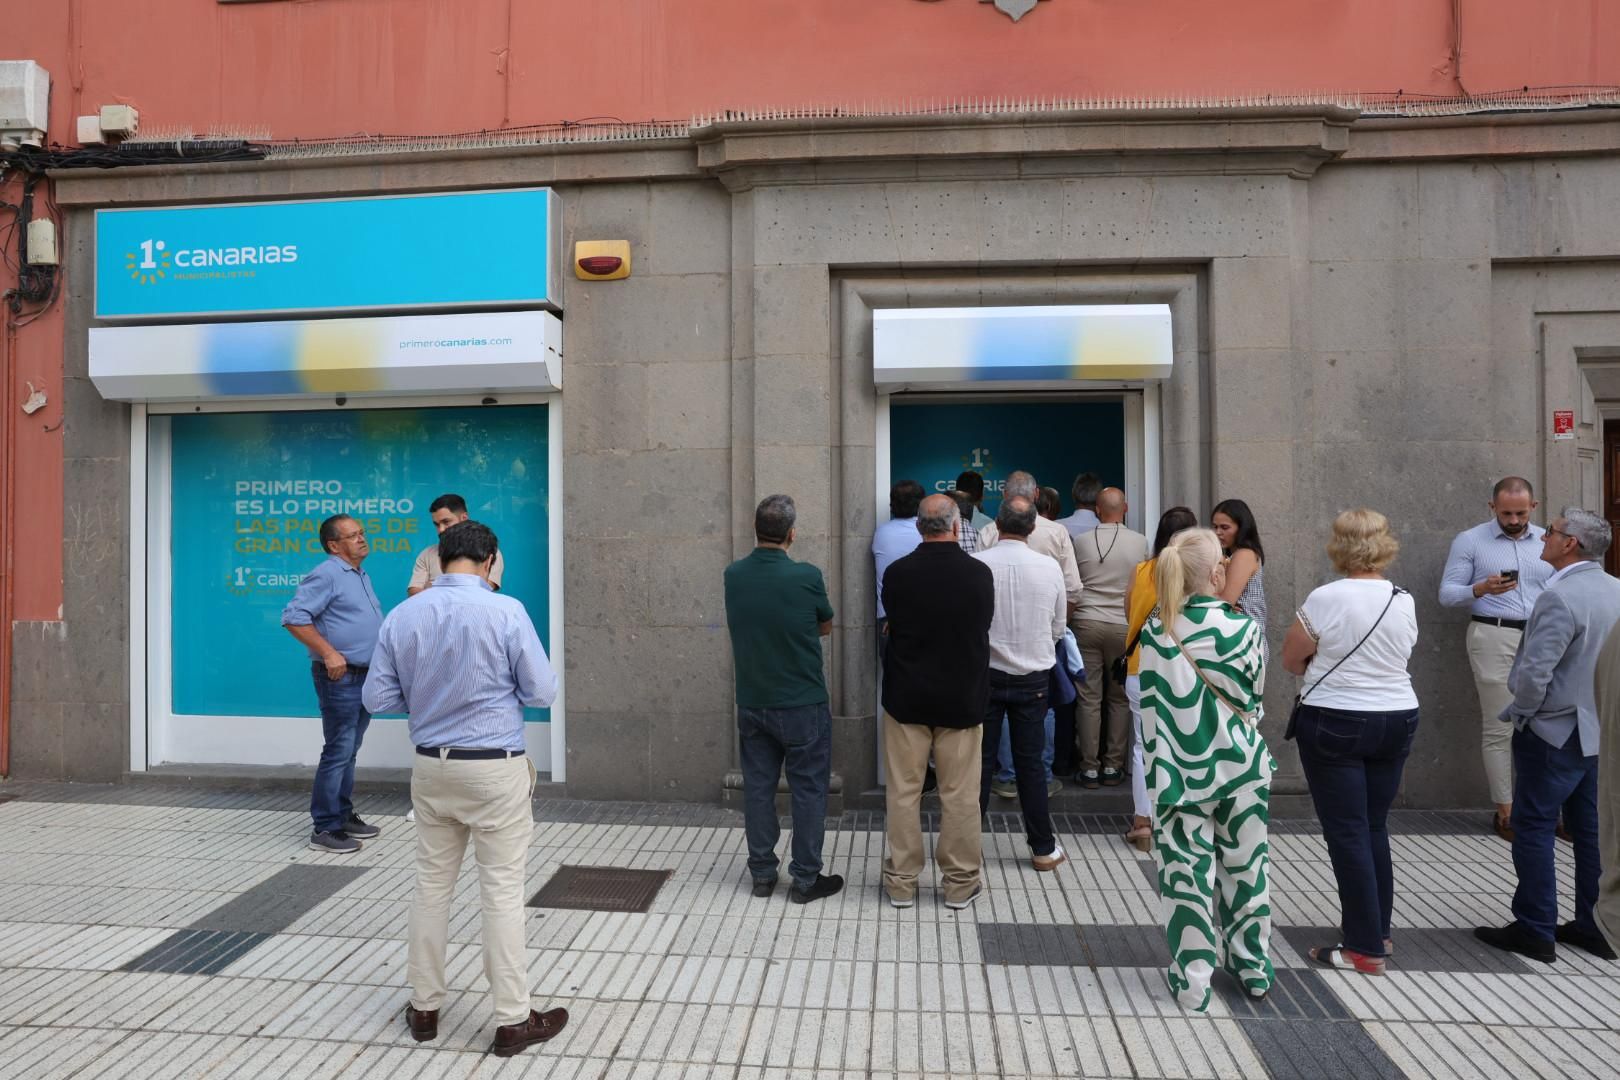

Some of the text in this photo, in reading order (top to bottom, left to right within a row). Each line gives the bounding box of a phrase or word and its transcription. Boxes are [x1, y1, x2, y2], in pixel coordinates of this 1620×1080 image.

[399, 337, 513, 349] primerocanarias.com
[235, 480, 343, 496] PRIMERO
[235, 498, 414, 515] ES LO PRIMERO
[235, 518, 279, 534] LAS
[387, 518, 419, 533] DE
[235, 538, 301, 553] GRAN
